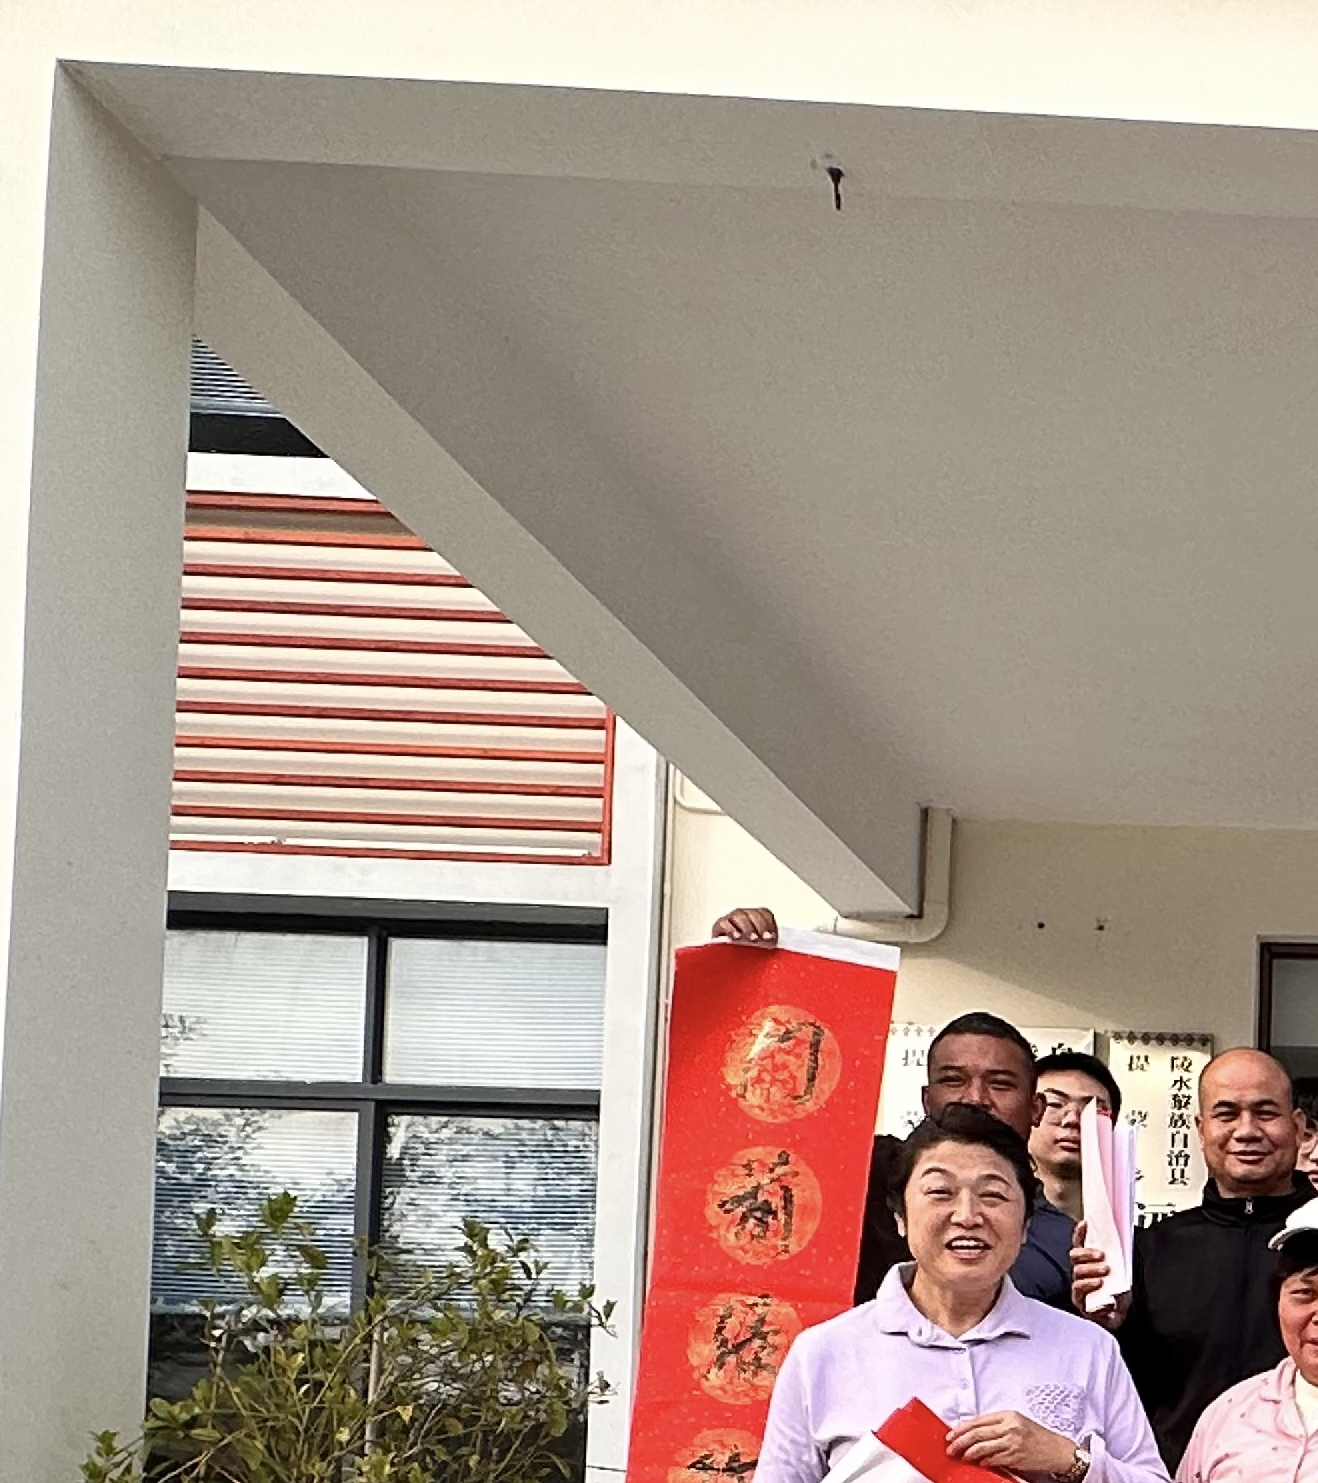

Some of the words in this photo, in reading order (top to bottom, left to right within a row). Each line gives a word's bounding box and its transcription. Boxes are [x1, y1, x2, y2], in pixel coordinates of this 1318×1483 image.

[1167, 1056, 1193, 1186] 陵水黎族自治县
